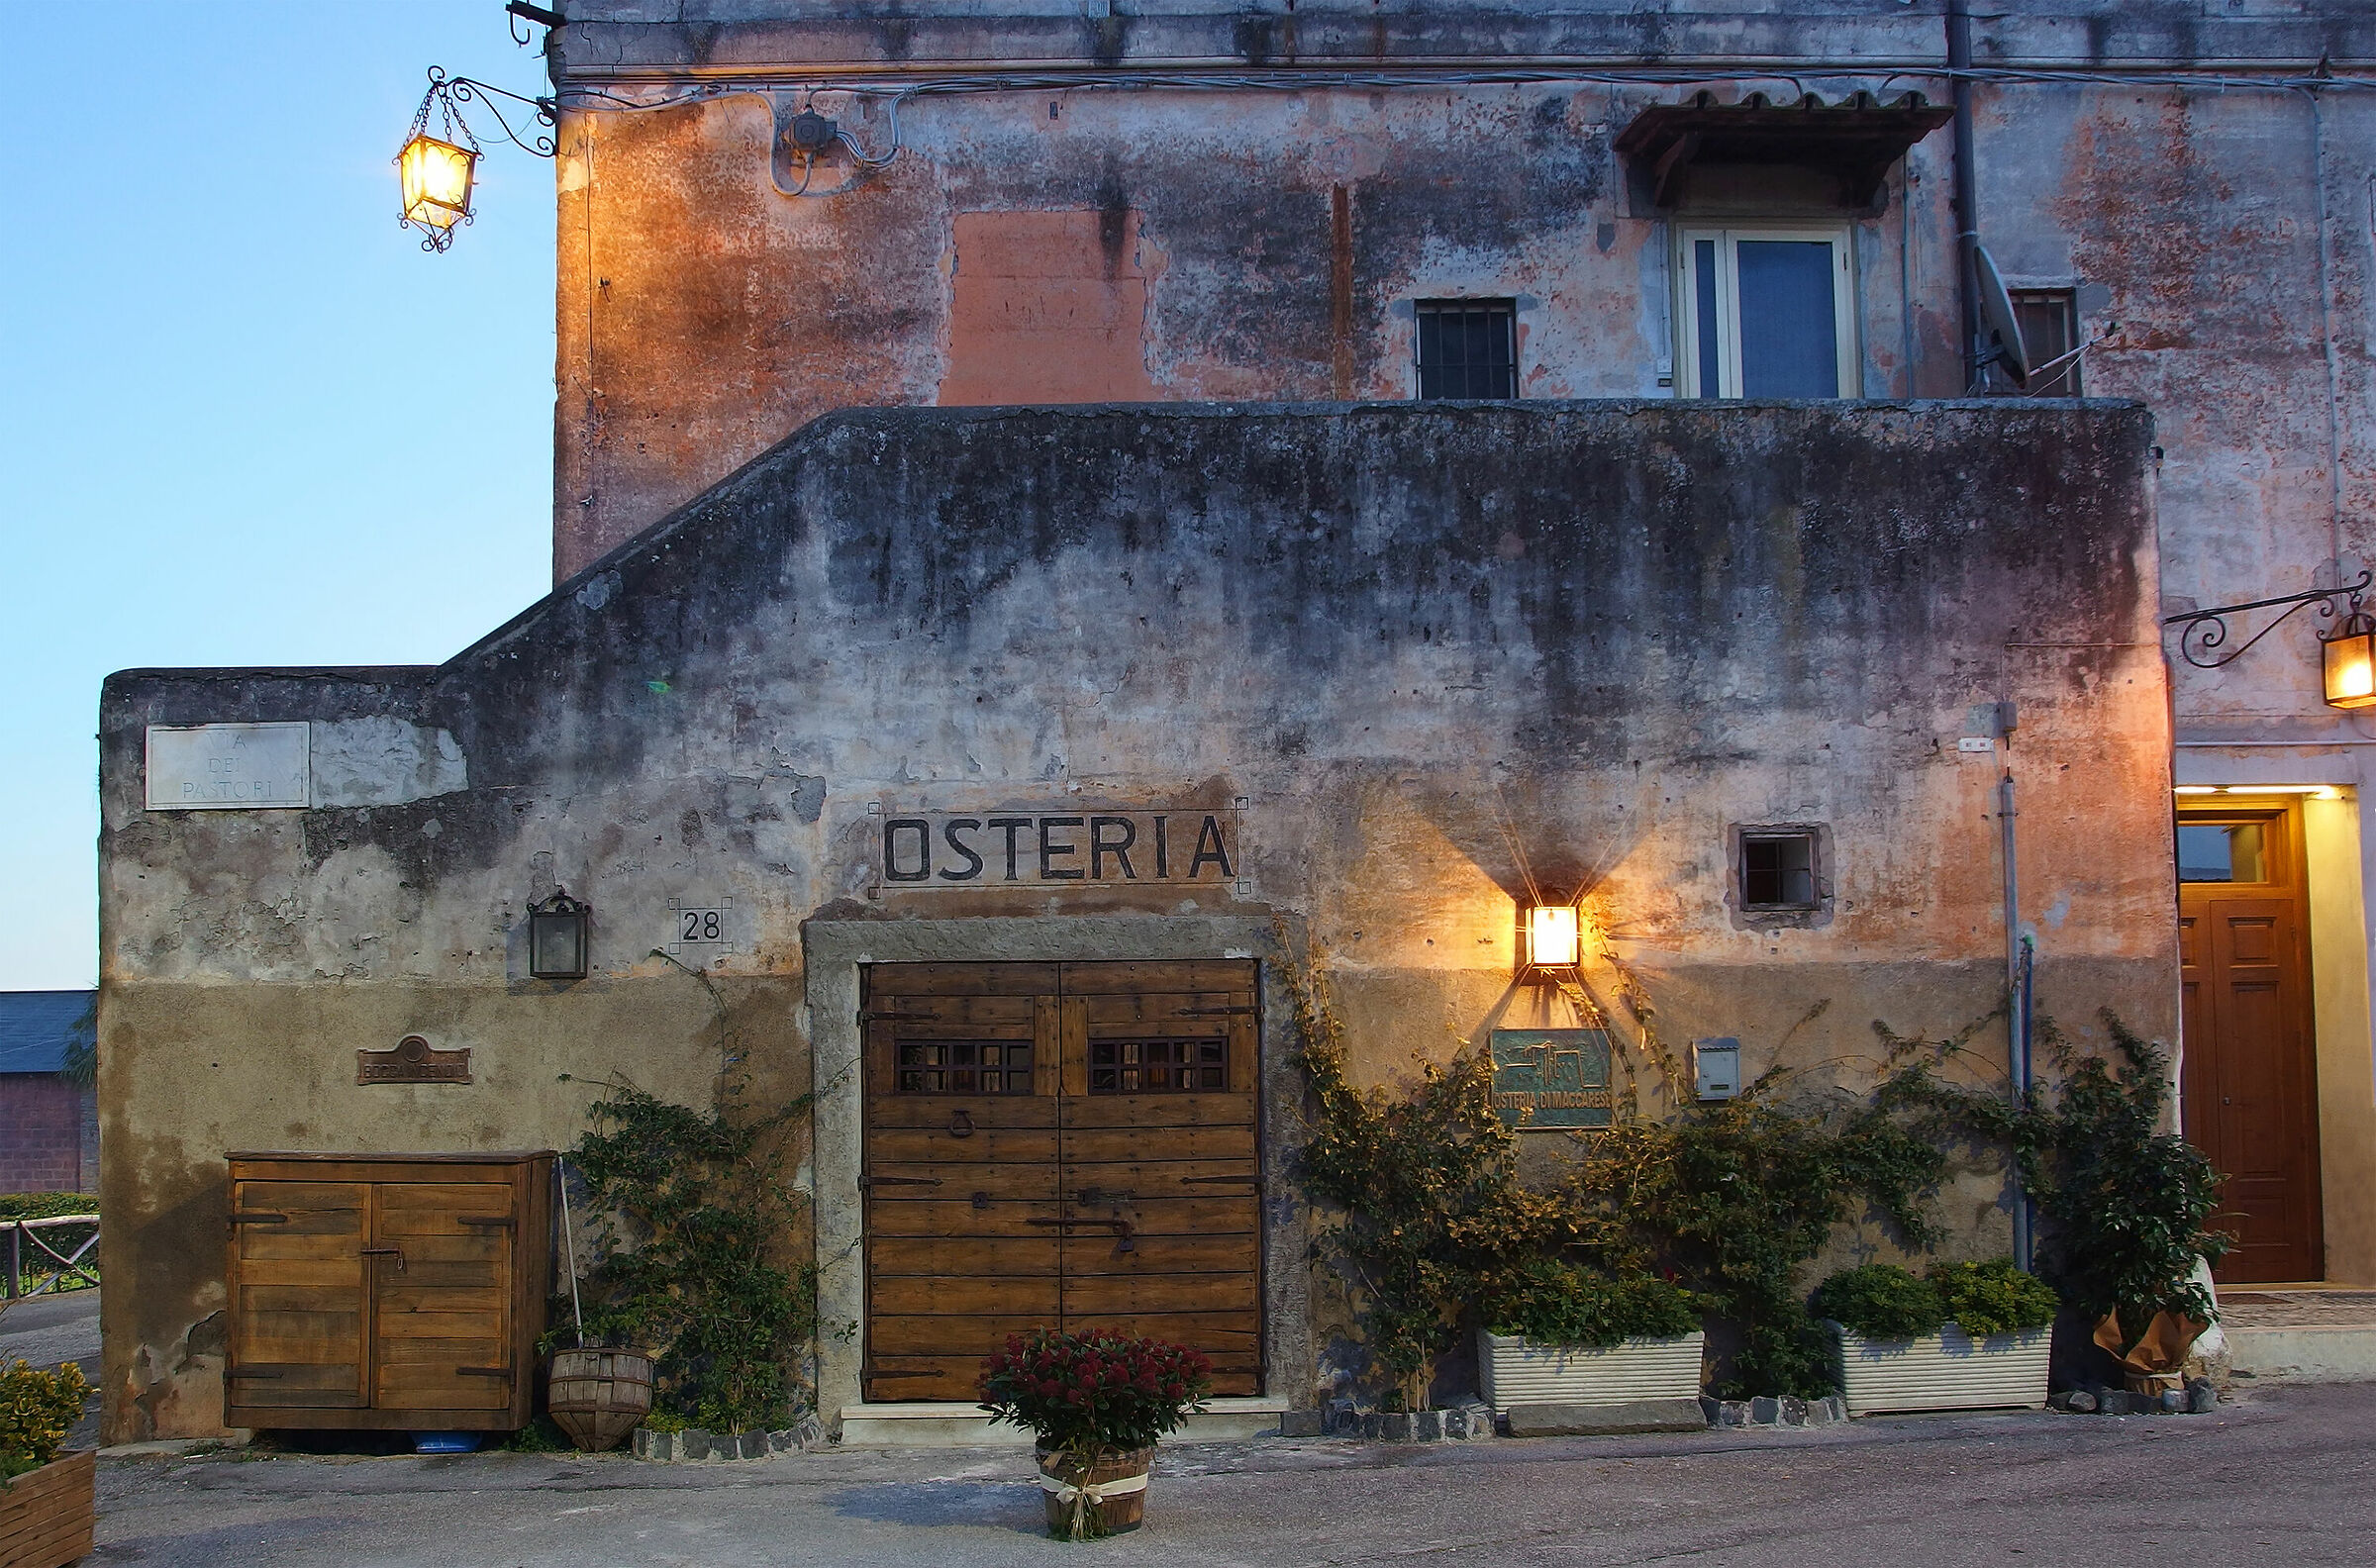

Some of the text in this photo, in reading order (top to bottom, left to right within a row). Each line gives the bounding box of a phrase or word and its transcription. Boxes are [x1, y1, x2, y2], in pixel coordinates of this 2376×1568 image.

[206, 733, 247, 749] VIA
[208, 757, 240, 773] DEI
[183, 781, 272, 799] PASTORI
[884, 815, 1236, 882] OSTERIA
[683, 911, 721, 940] 28
[1493, 1091, 1536, 1109] OSTERIA
[1539, 1091, 1551, 1109] DI
